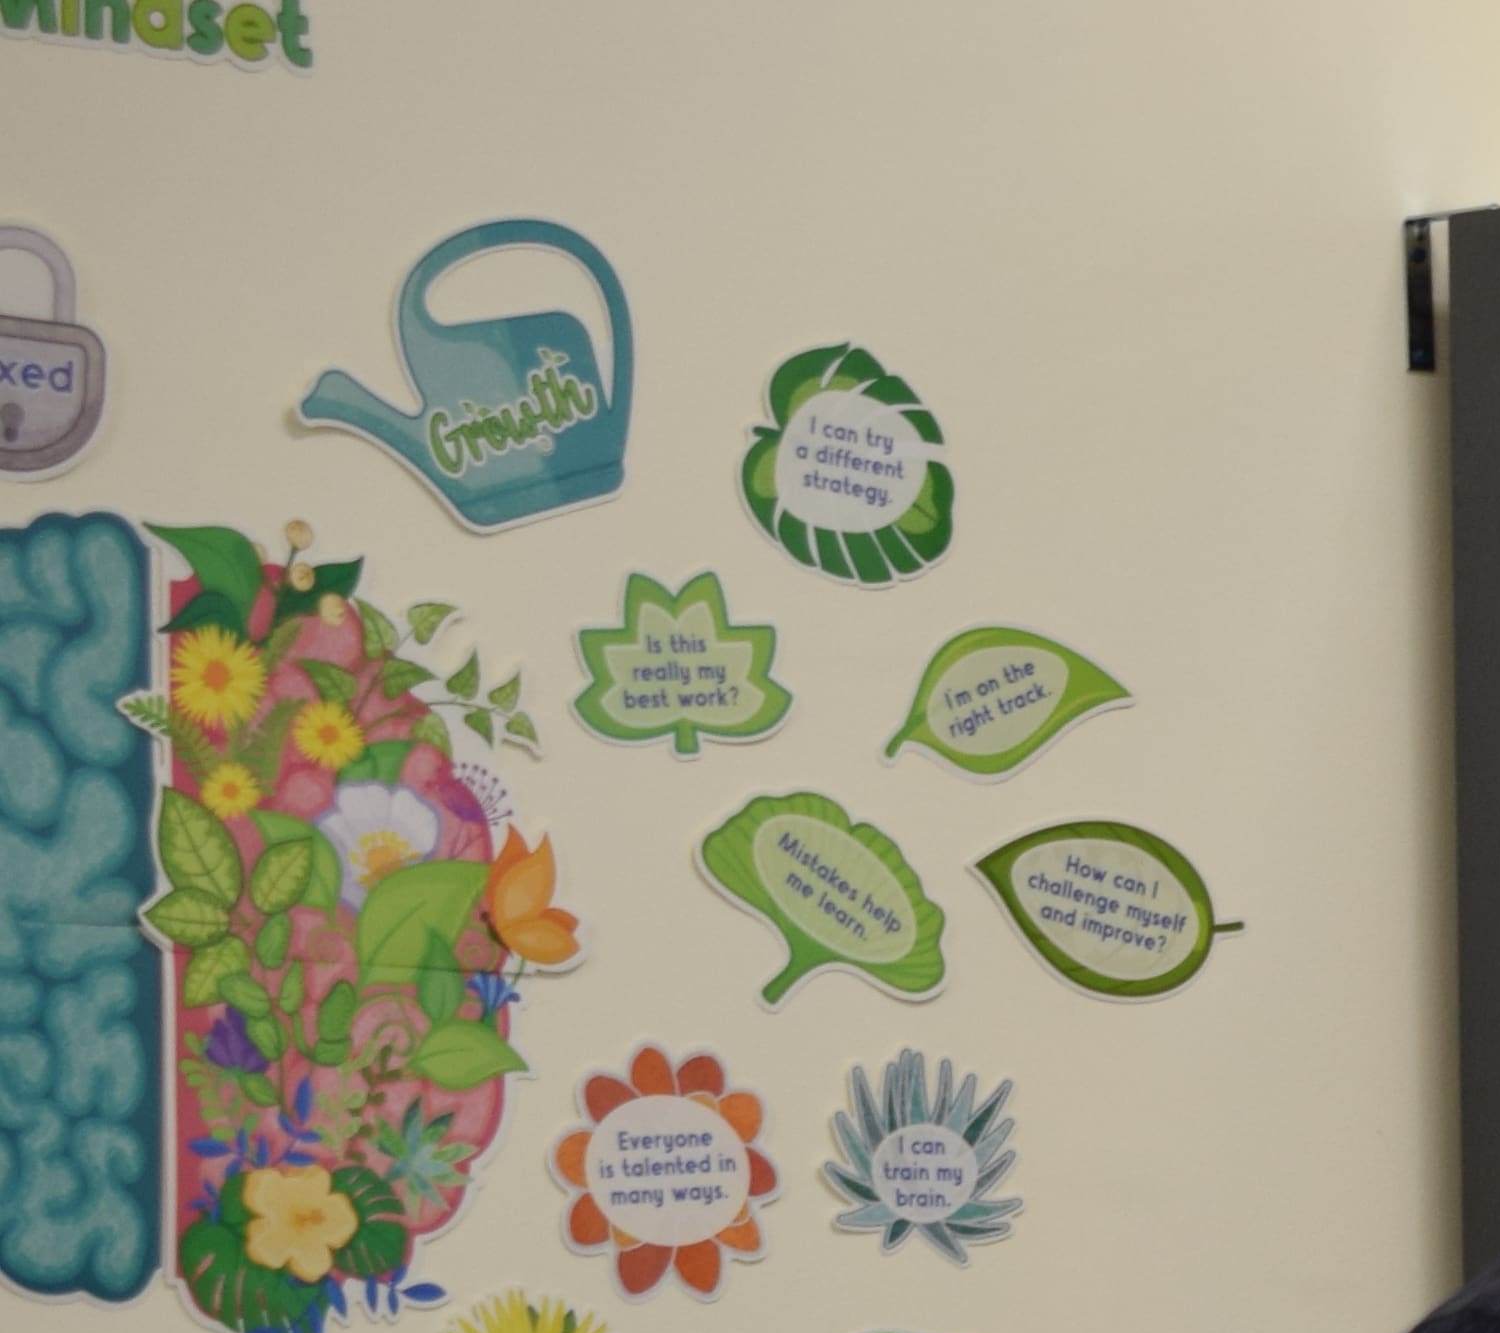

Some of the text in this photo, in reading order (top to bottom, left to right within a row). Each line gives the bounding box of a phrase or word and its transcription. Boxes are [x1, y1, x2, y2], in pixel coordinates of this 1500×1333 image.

[0, 360, 73, 393] xed
[430, 366, 594, 474] Growth
[810, 415, 894, 455] I can try
[796, 446, 905, 479] a different
[803, 469, 892, 507] strategy.
[646, 633, 706, 654] Is this
[632, 662, 726, 686] really my
[976, 679, 999, 697] on
[1003, 663, 1034, 684] the
[623, 686, 739, 709] best work?
[949, 683, 1053, 738] right track.
[778, 832, 902, 934] Mistakes help
[1065, 854, 1159, 899] How can I
[786, 872, 867, 941] me learn.
[1028, 872, 1187, 933] challenge myself
[1041, 904, 1168, 952] and improve?
[618, 1131, 712, 1154] Everyone
[899, 1135, 945, 1155] I can
[600, 1153, 736, 1179] is talented in
[884, 1161, 962, 1187] train my
[611, 1185, 729, 1208] many ways.
[896, 1188, 952, 1207] brain.
